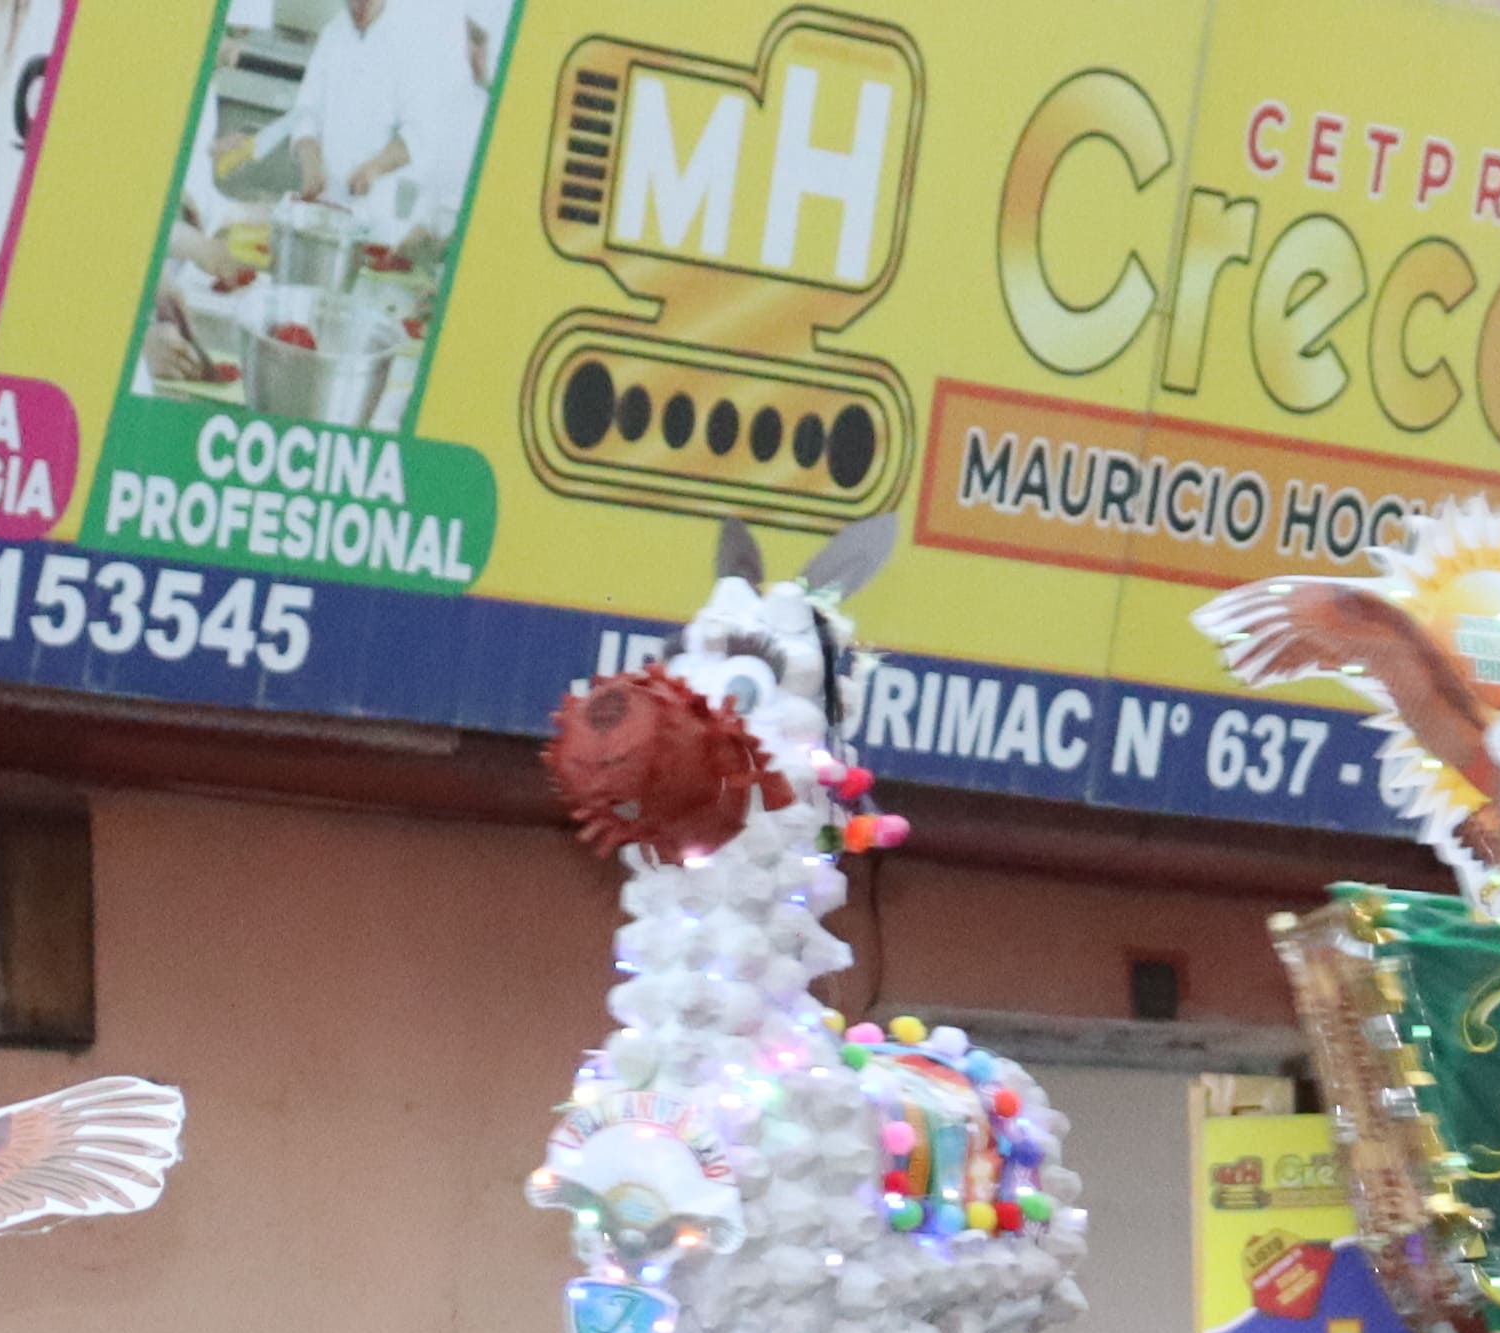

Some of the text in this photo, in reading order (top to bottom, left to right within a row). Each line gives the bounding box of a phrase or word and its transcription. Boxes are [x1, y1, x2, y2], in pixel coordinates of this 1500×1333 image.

[612, 72, 893, 288] MH
[196, 414, 407, 506] COCINA
[959, 432, 1267, 545] MAURICIO
[104, 471, 473, 582] PROFESIONAL
[1111, 695, 1192, 780] N°
[1204, 708, 1329, 798] 637
